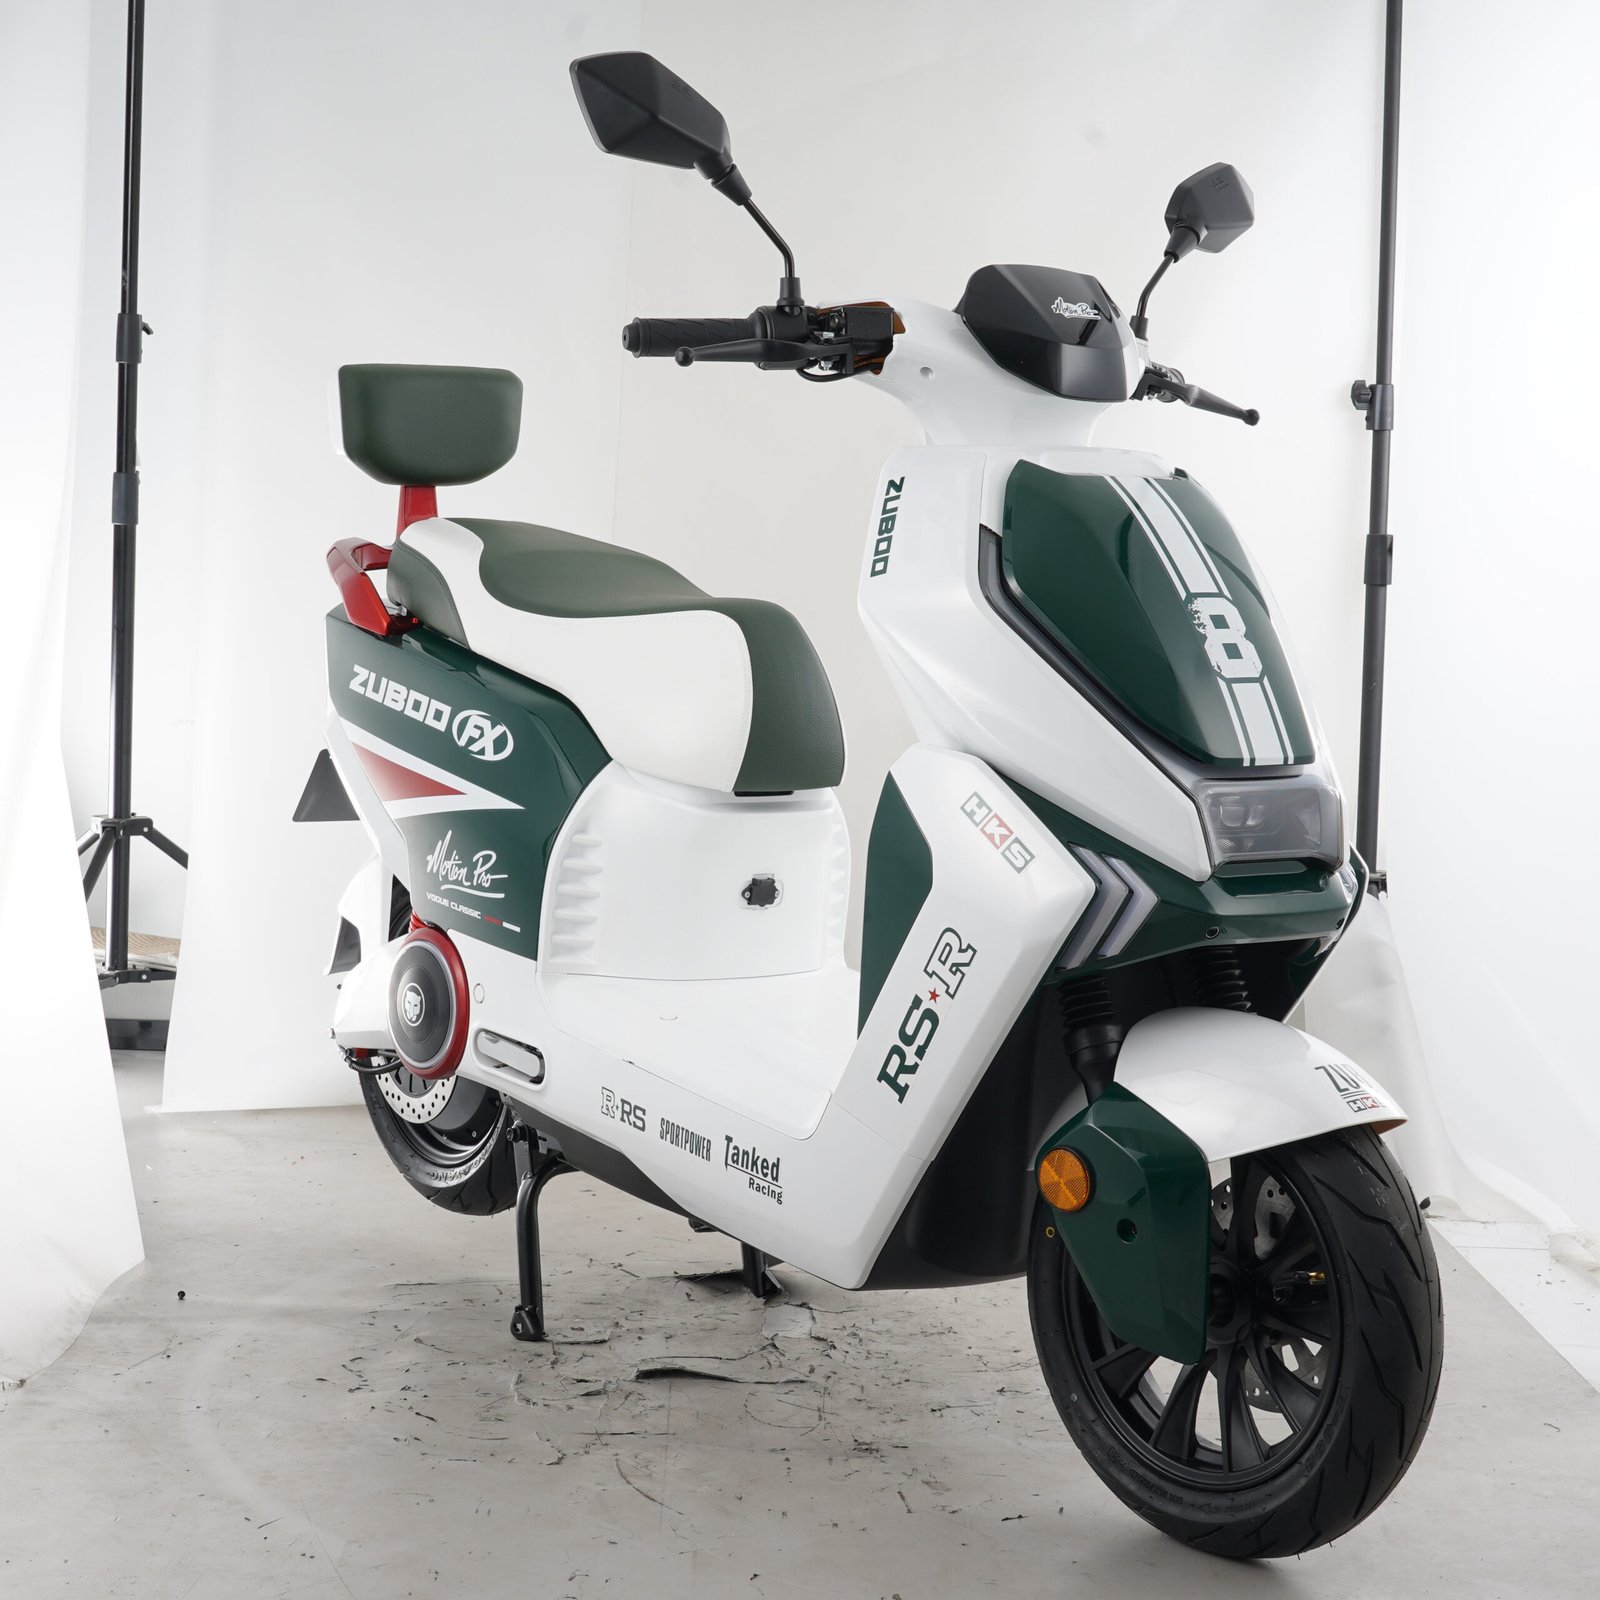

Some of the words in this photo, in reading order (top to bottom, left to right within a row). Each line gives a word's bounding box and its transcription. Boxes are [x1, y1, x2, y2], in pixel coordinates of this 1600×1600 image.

[870, 476, 905, 577] ZUBOO
[1187, 597, 1263, 679] 8
[349, 664, 452, 732] ZUBOO
[456, 712, 509, 759] FX
[426, 830, 471, 886] Motion
[472, 850, 508, 887] Pro
[960, 791, 1035, 873] HKS
[426, 891, 450, 910] VOGUE
[450, 901, 482, 920] CLASSIC
[659, 1117, 711, 1162] SPORTPOWER
[725, 1134, 781, 1184] Tanked
